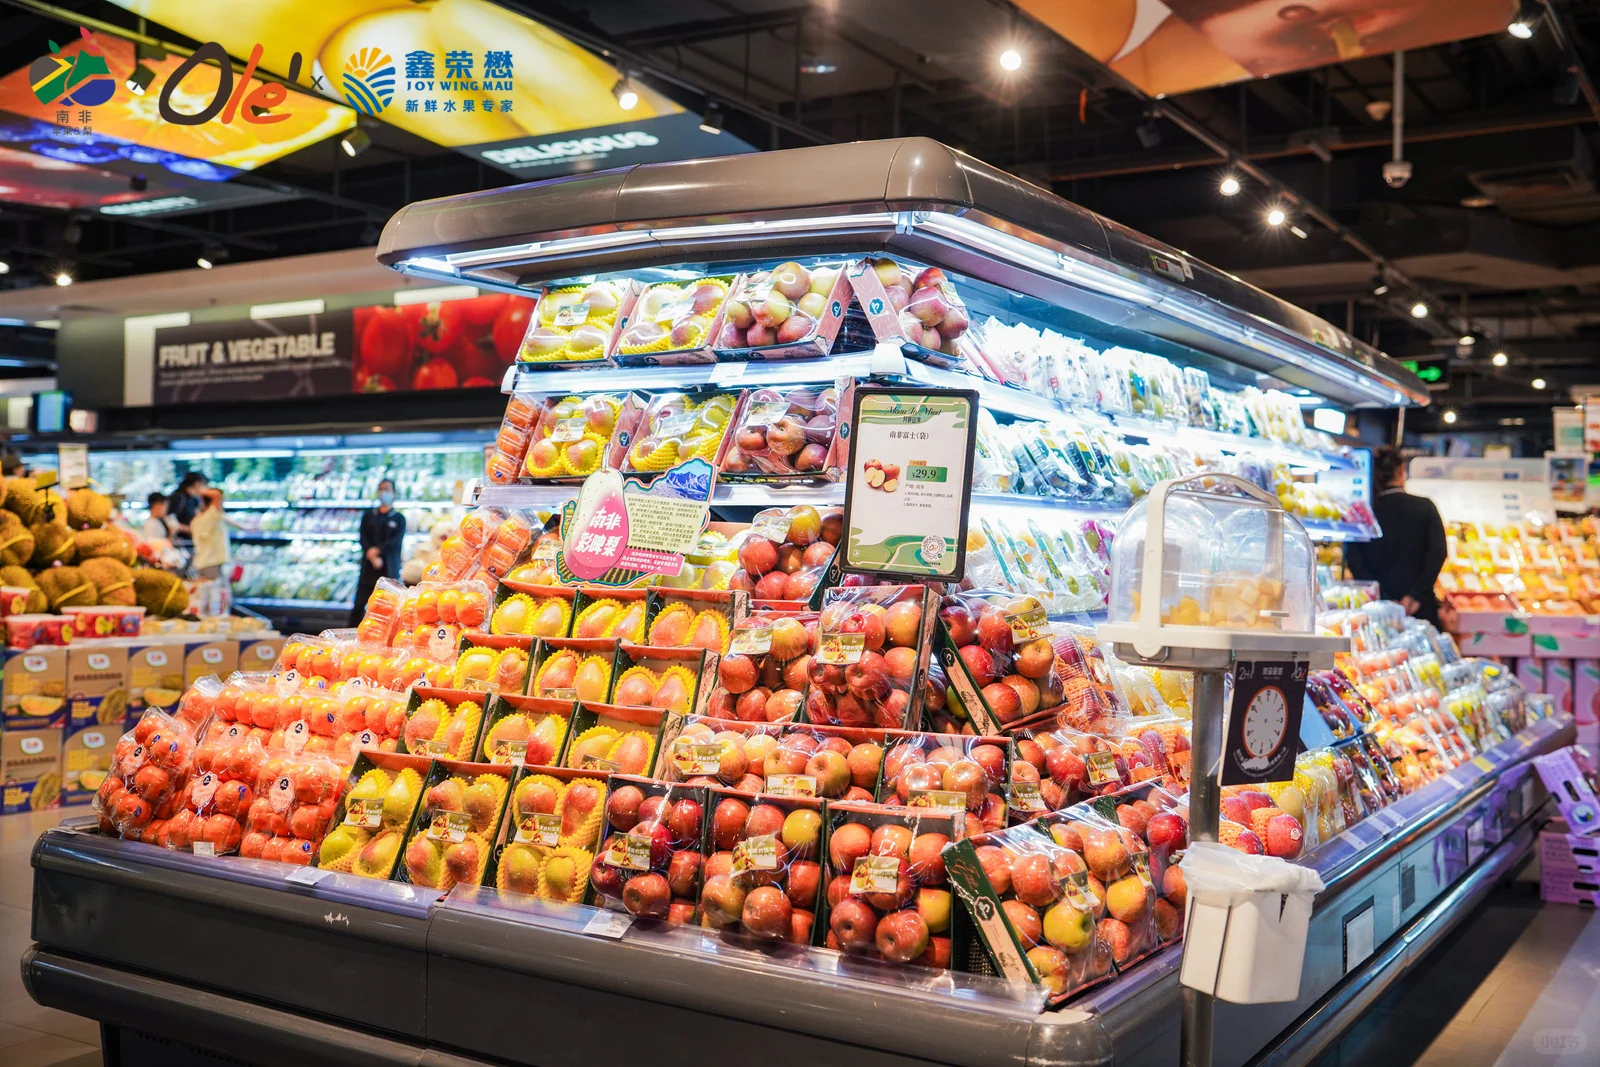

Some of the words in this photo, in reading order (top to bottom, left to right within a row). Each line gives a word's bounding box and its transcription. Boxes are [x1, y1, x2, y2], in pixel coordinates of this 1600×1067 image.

[159, 344, 209, 368] FRUIT
[211, 341, 226, 365] &
[227, 332, 335, 363] VEGETABLE
[912, 468, 937, 479] ¥29.9
[588, 505, 623, 531] 南非
[574, 532, 623, 557] 彩啤梨
